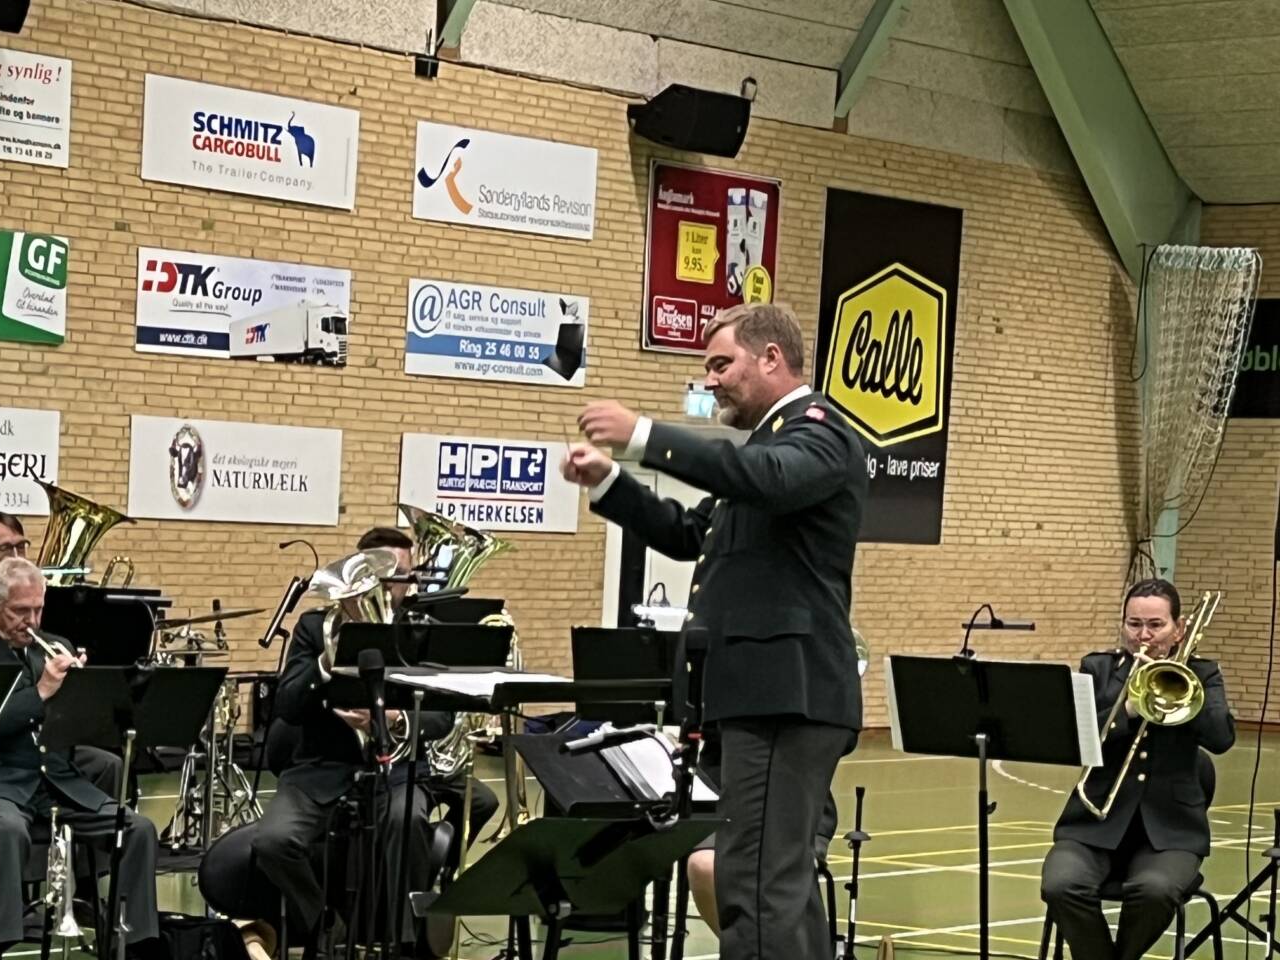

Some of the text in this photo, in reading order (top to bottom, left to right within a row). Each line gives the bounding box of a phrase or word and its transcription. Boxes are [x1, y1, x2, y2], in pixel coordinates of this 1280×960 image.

[193, 111, 283, 145] SCHMITZ
[192, 134, 281, 162] CARGOBULL
[192, 160, 213, 173] The
[553, 194, 592, 216] Revision
[28, 238, 65, 274] GF
[212, 281, 263, 306] Group
[447, 288, 482, 311] AGR
[490, 293, 546, 318] Consult
[459, 340, 482, 358] Ring
[887, 454, 908, 476] lave
[910, 456, 940, 481] priser
[211, 469, 308, 492] NATURMÆLK
[502, 480, 543, 492] TRANSPORT
[4, 492, 30, 507] 3334
[460, 503, 543, 523] THERKELSEN
